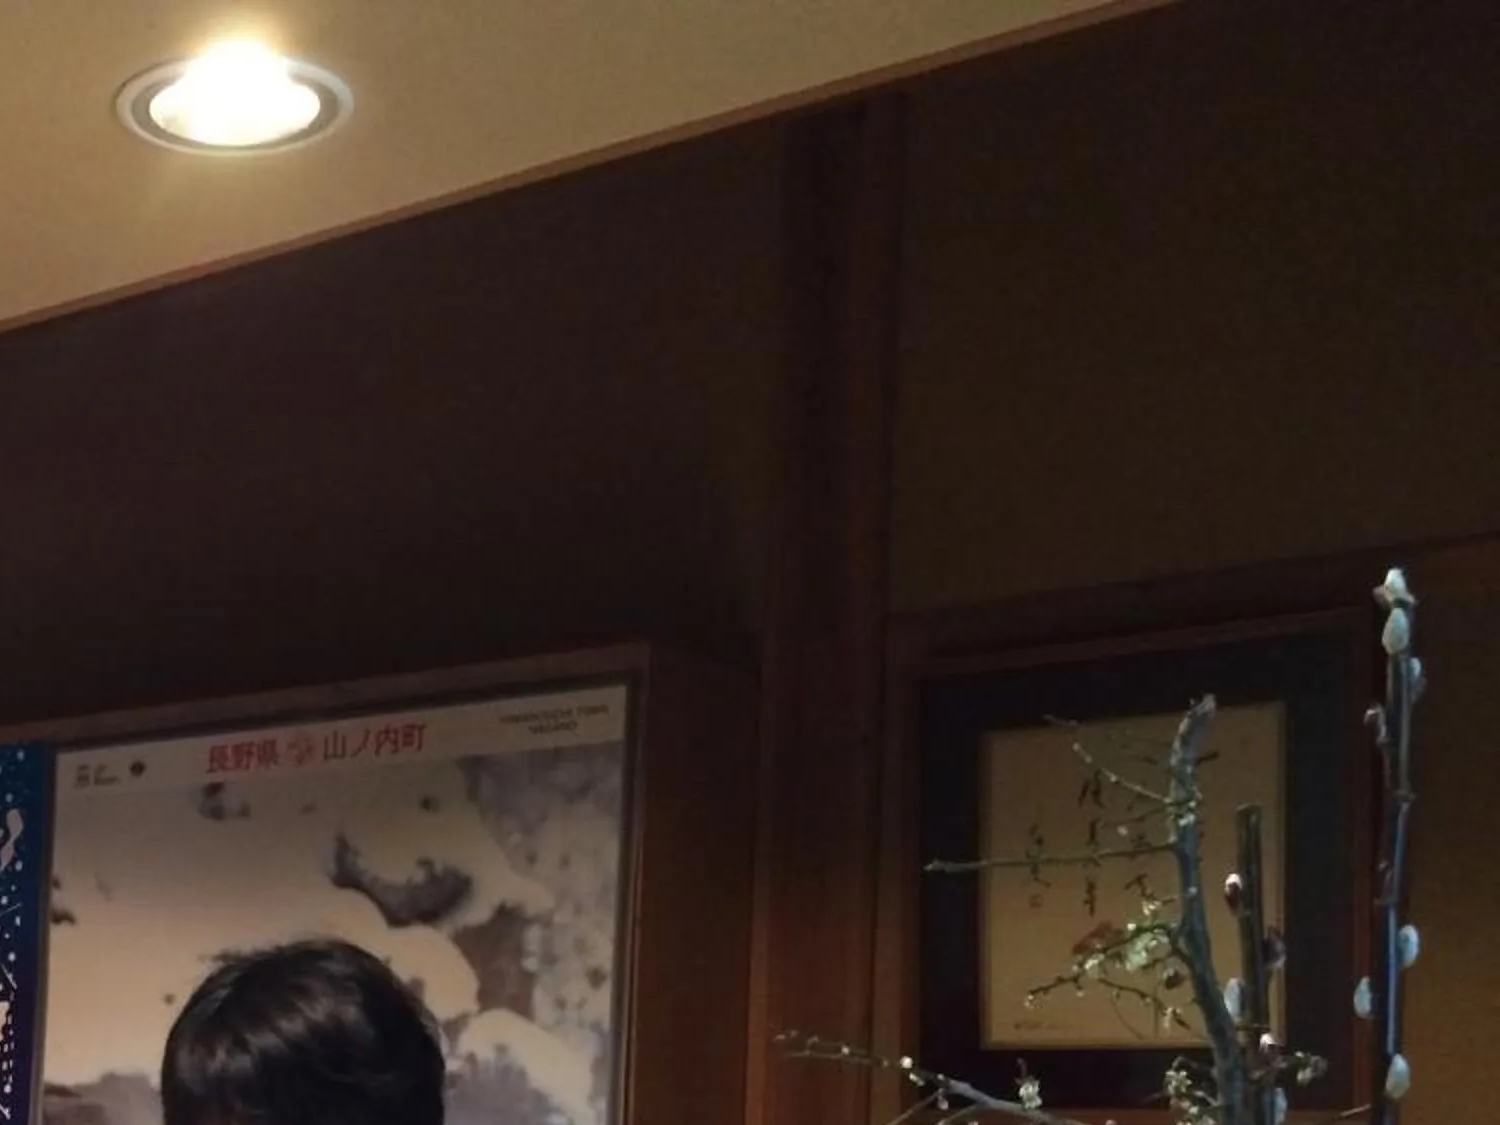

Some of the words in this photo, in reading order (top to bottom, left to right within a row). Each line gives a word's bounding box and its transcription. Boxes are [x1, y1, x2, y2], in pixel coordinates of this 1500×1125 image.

[206, 738, 280, 773] 長野県
[324, 723, 428, 761] 山ノ内町
